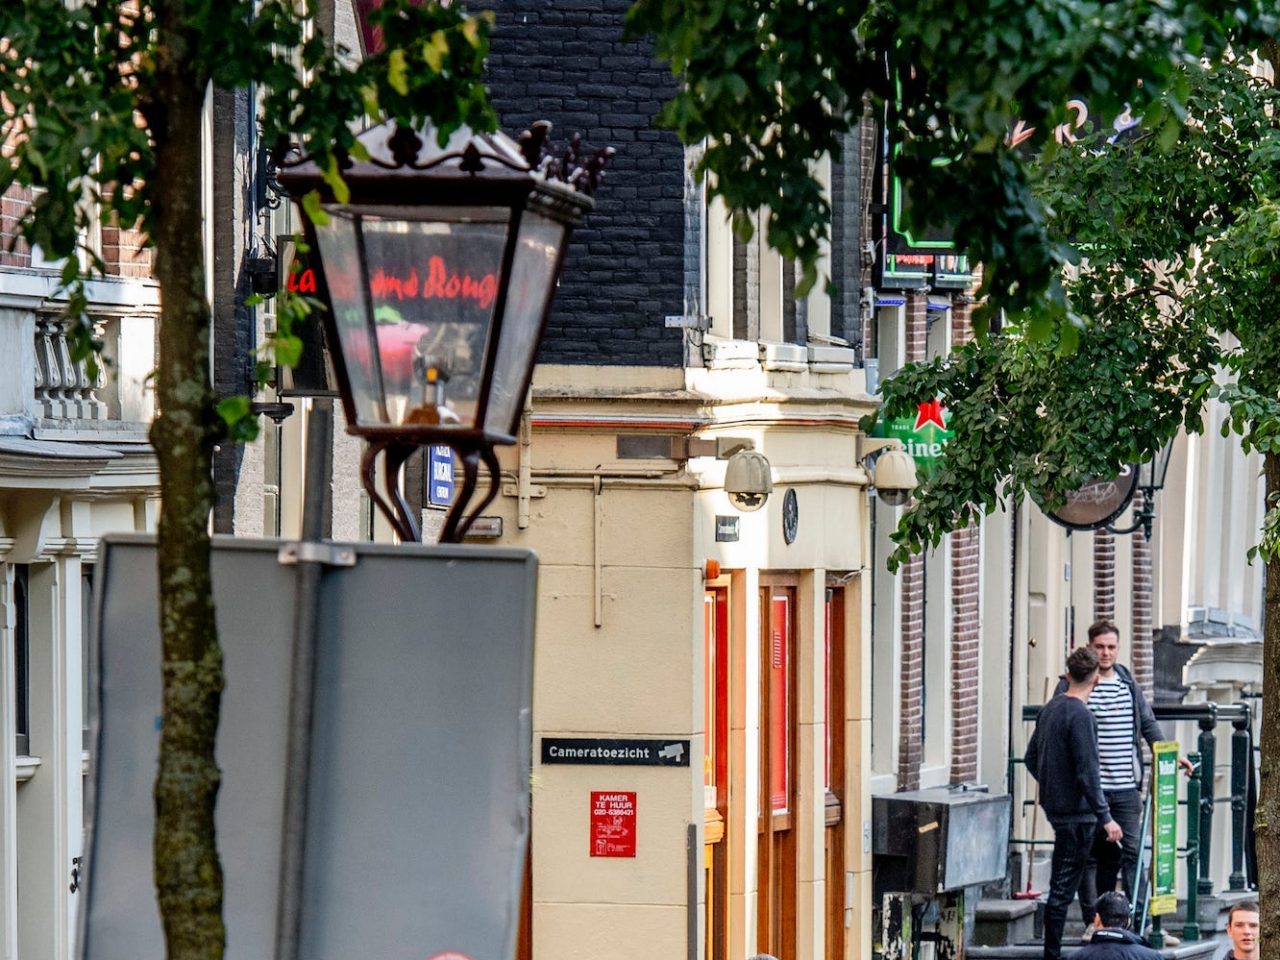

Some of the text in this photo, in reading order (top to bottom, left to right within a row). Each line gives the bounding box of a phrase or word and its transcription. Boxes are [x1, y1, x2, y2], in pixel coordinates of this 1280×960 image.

[424, 255, 497, 309] Roug
[549, 746, 650, 759] Cameratoezicht
[595, 801, 632, 809] TE HUUR
